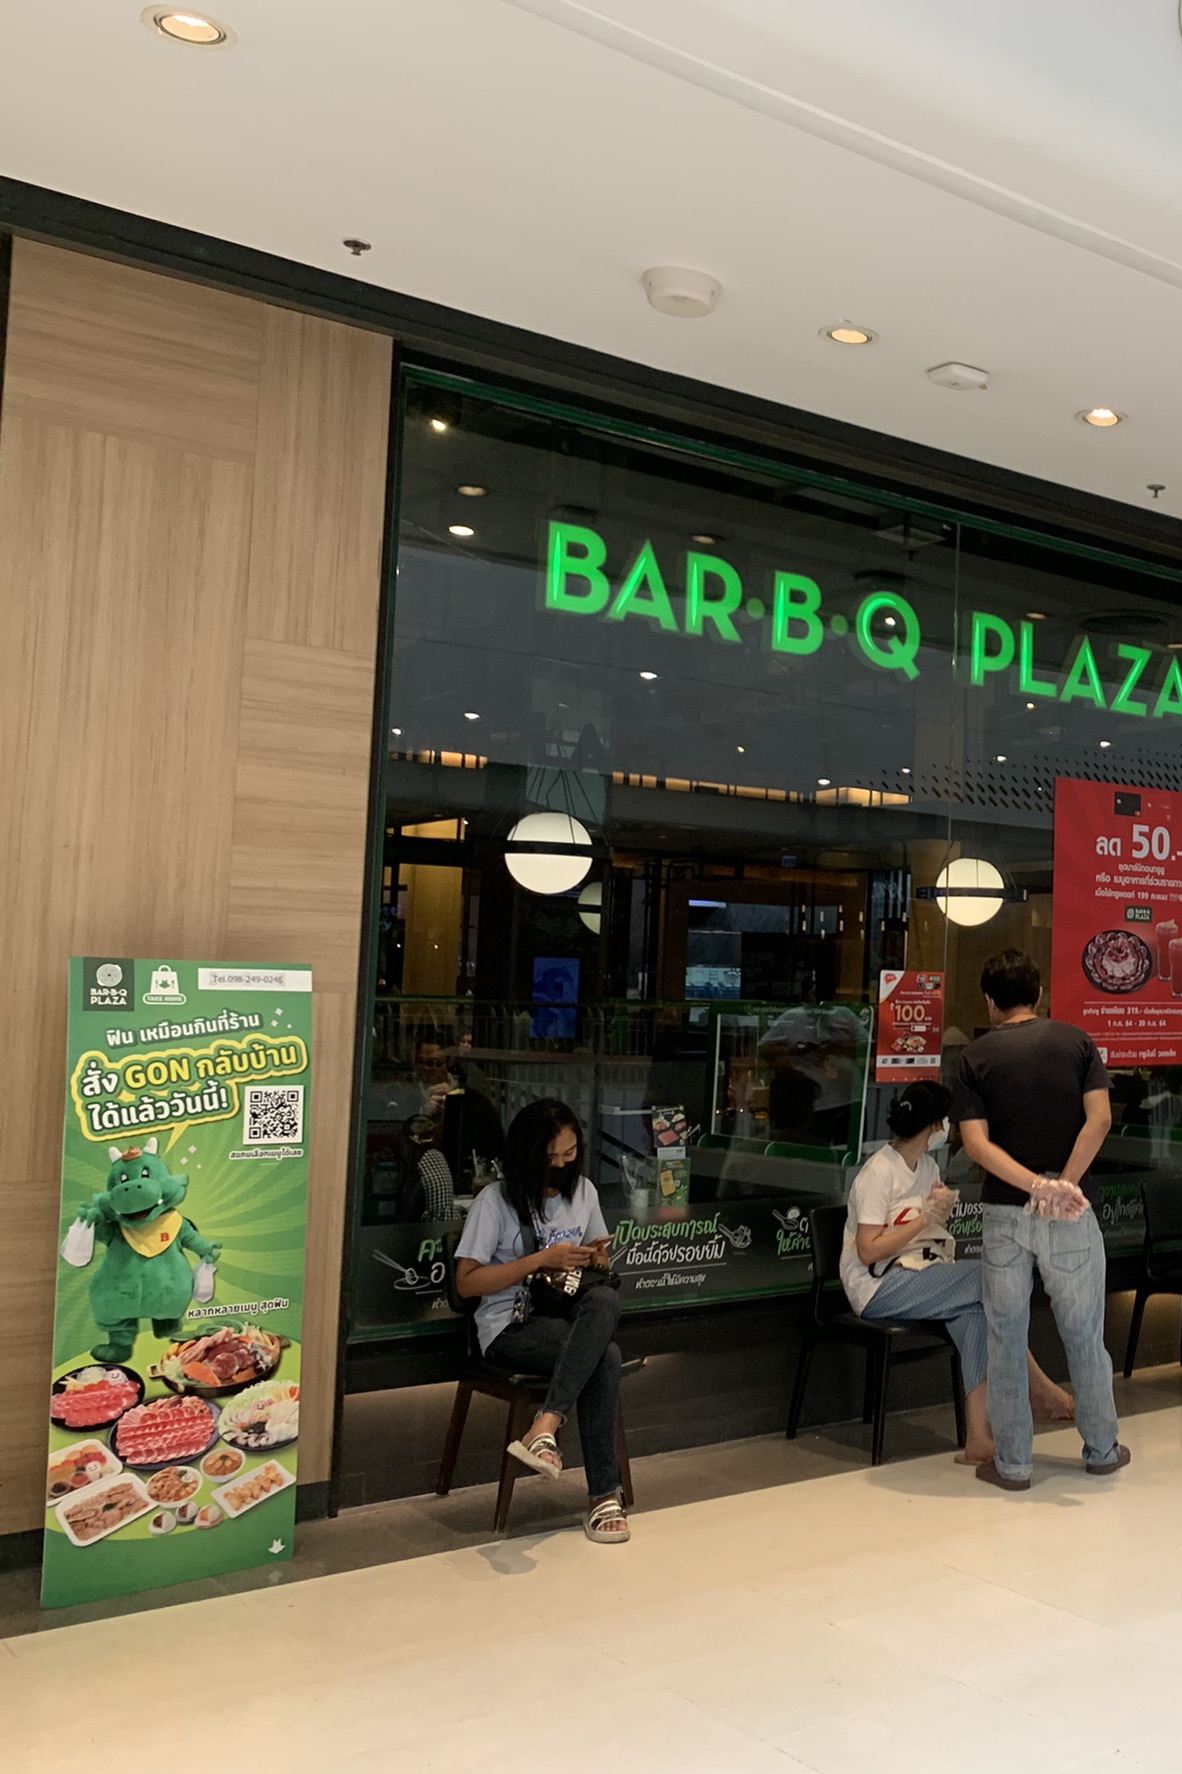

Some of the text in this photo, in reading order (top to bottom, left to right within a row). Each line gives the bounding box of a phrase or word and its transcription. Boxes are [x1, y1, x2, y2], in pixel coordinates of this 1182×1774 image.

[1095, 836, 1121, 857] ลด
[90, 996, 127, 1005] PLAZA
[895, 1005, 926, 1022] 100
[107, 1009, 260, 1046] ฟิน เหมือนกินที่ร้าน
[82, 1043, 297, 1097] สั่ง GON กลับบ้าน
[88, 1080, 229, 1131] ได้แล้ววันนี้!
[160, 1232, 169, 1242] B
[187, 1299, 288, 1318] หลากหลายเมนู สุดฟิน
